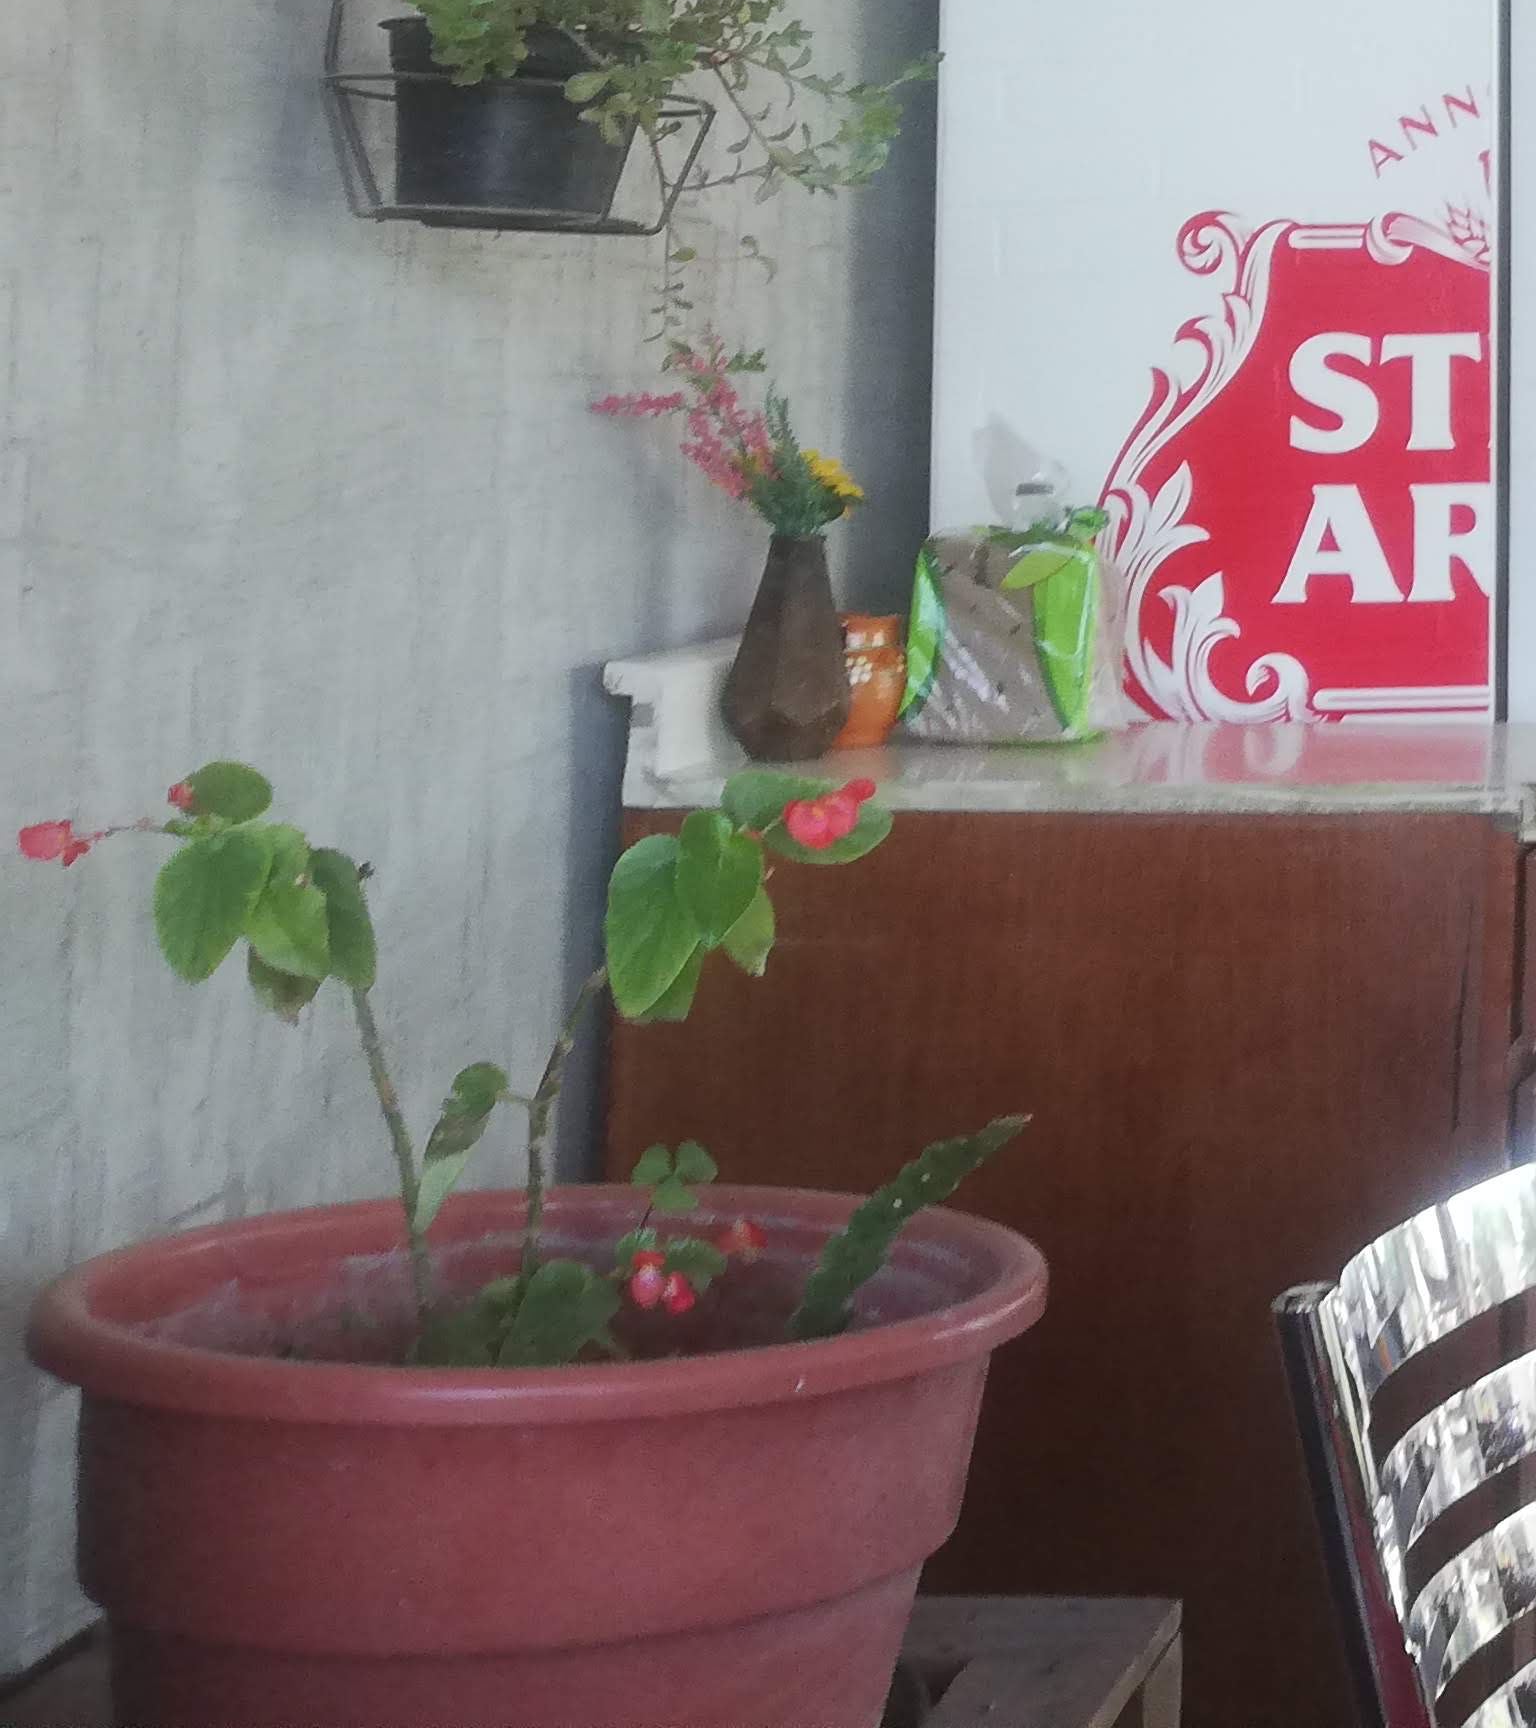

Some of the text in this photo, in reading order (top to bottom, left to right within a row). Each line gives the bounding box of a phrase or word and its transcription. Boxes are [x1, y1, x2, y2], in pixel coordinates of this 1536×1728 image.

[1368, 83, 1490, 179] ANN
[1288, 331, 1490, 454] ST
[1270, 481, 1491, 603] AR
